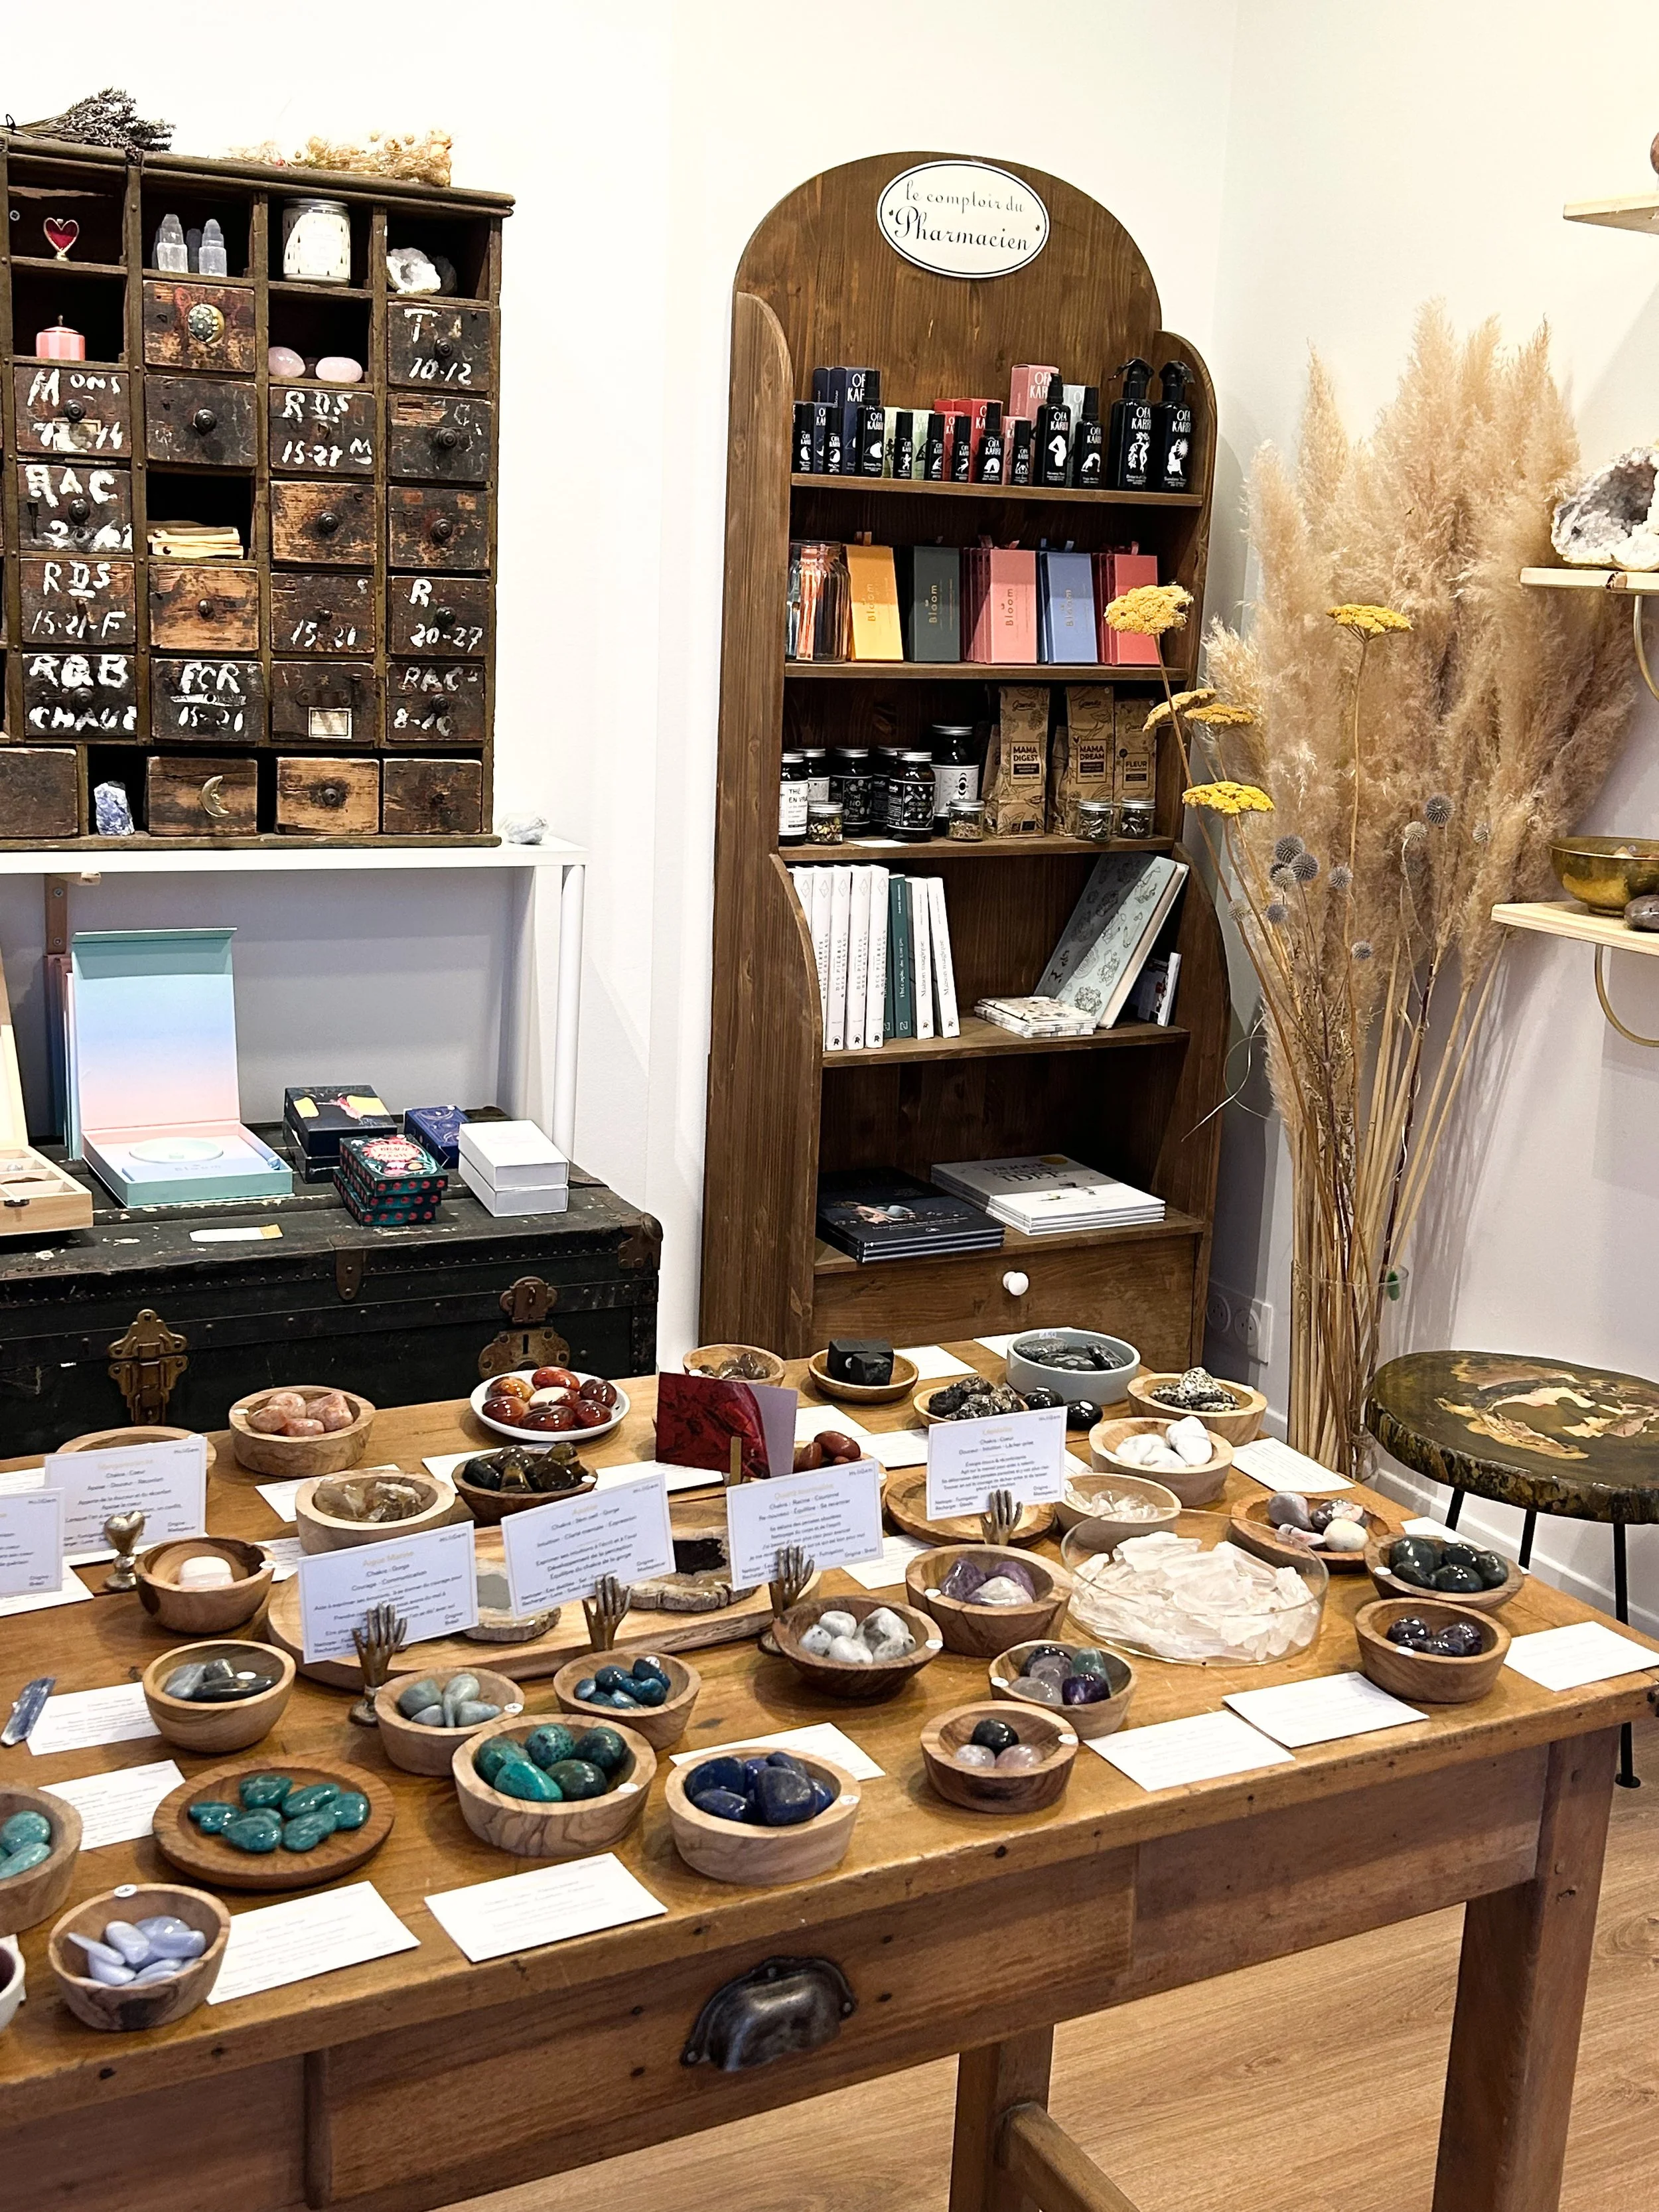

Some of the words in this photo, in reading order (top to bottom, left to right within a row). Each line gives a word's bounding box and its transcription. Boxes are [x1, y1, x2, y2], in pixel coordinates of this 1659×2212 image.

[906, 180, 920, 201] le
[926, 191, 1002, 214] comptoir
[1005, 196, 1025, 212] du
[894, 206, 1030, 250] Pharmacien
[867, 583, 876, 622] Bloom
[928, 584, 938, 624] Bloom
[1005, 587, 1014, 626] Bloom
